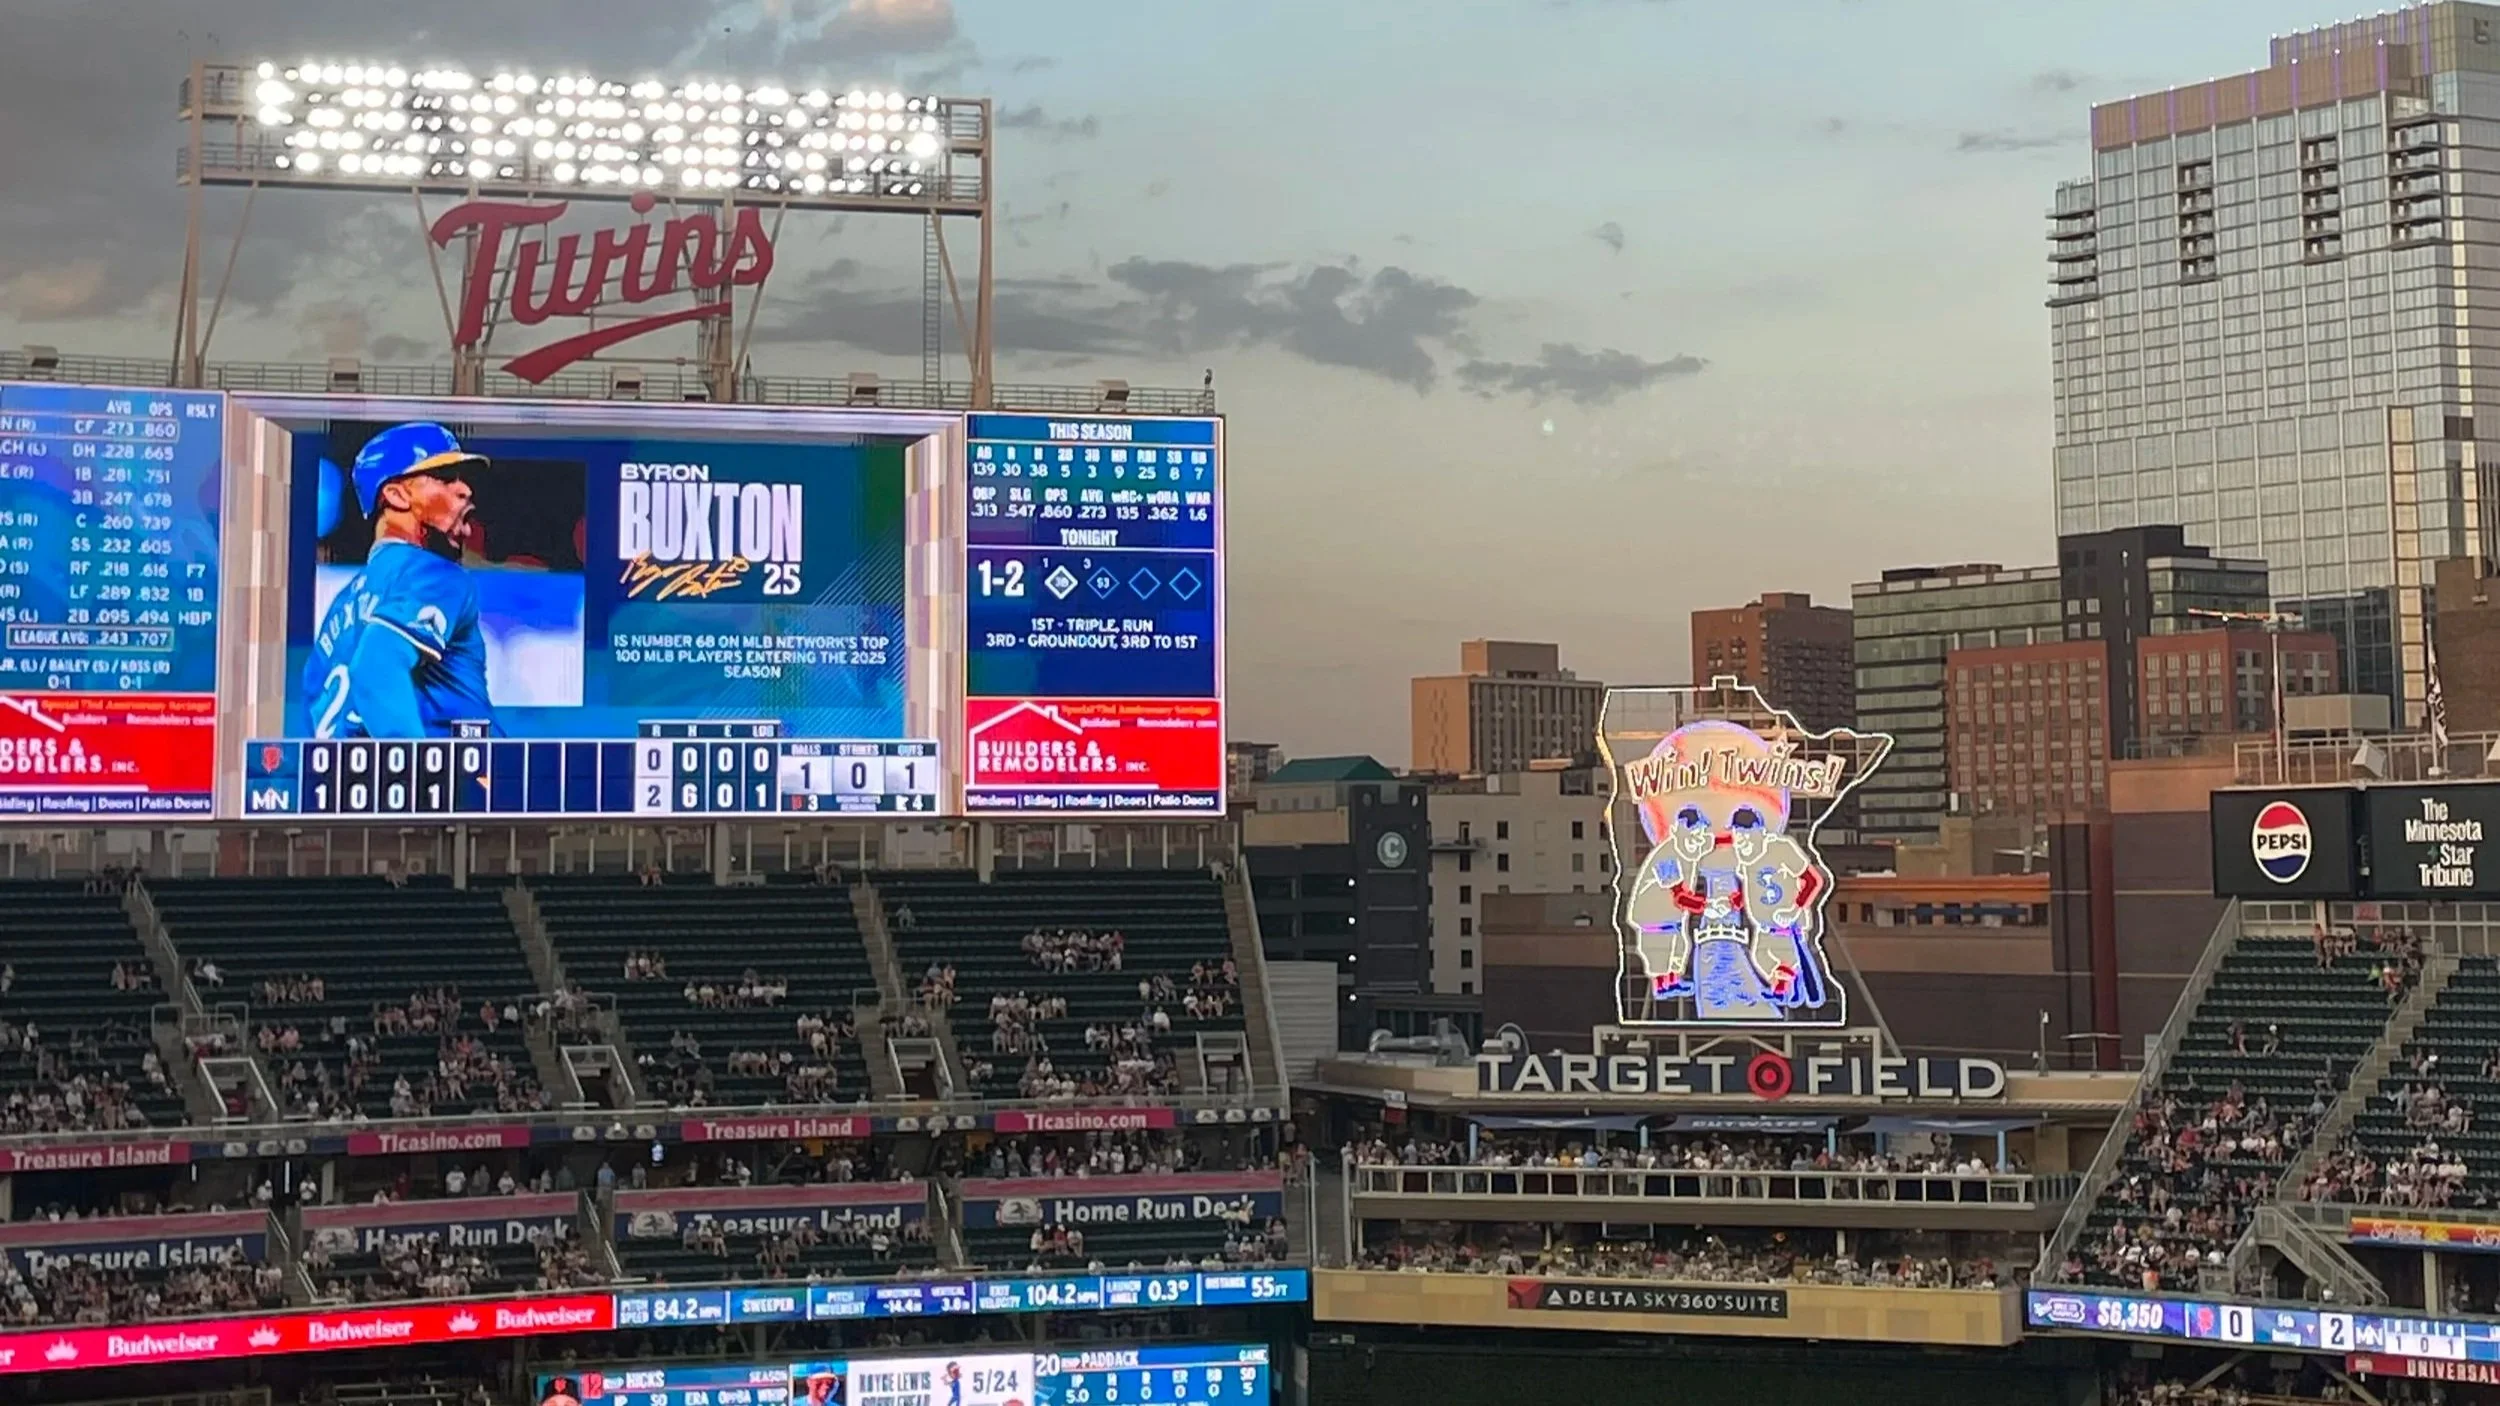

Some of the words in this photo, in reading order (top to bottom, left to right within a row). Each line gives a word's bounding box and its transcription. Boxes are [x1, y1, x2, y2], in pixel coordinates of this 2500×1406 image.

[430, 190, 773, 346] Twins
[106, 400, 131, 415] AVG
[149, 402, 173, 417] OPS
[186, 403, 216, 418] RSLT
[74, 420, 95, 434] CF
[102, 421, 134, 436] .273
[141, 423, 176, 437] .860
[1049, 423, 1078, 440] THIS
[1081, 424, 1132, 441] SEASON
[72, 443, 96, 458] DH
[102, 445, 135, 459] .228
[141, 447, 174, 461] .665
[75, 467, 92, 481] 1B
[102, 468, 131, 482] .281
[620, 463, 709, 481] BYRON
[973, 463, 995, 476] 139
[1002, 464, 1021, 477] 30
[1029, 464, 1048, 477] 38
[1138, 467, 1156, 479] 25
[71, 491, 93, 505] 3B
[100, 492, 133, 506] .247
[76, 514, 87, 527] C
[99, 516, 133, 530] .260
[619, 482, 802, 562] BUXTON
[971, 505, 998, 517] .313
[1005, 505, 1036, 518] .547
[1078, 506, 1107, 519] .273
[1148, 507, 1178, 520] .362
[71, 538, 91, 551] SS
[99, 539, 131, 553] .232
[138, 540, 172, 554] .605
[1060, 528, 1119, 546] TONIGHT
[70, 562, 91, 575] RF
[99, 563, 130, 577] .218
[139, 564, 168, 578] .616
[186, 565, 206, 579] F7
[763, 563, 801, 595] 25
[977, 559, 1025, 597] 1-2
[70, 584, 89, 599] LF
[96, 585, 131, 600] .289
[136, 586, 170, 601] .832
[187, 588, 204, 602] 1B
[68, 608, 90, 623] 2B
[96, 609, 130, 624] .095
[135, 610, 170, 624] .494
[178, 611, 212, 626] HBP
[1031, 618, 1054, 631] 1ST
[1067, 619, 1120, 633] TRIPLE,
[1123, 619, 1153, 632] RUN
[14, 630, 59, 645] LEAGUE
[96, 631, 128, 646] .243
[136, 633, 168, 646] .707
[614, 634, 629, 648] IS
[631, 634, 692, 648] NUMBER
[695, 635, 716, 648] 68
[718, 636, 740, 648] ON
[743, 636, 774, 649] MLB
[776, 636, 858, 650] NETWORK'S
[860, 637, 889, 650] TOP
[986, 634, 1016, 647] 3RD
[1028, 634, 1118, 650] GROUNDOUT,
[1121, 635, 1150, 648] 3RD
[1153, 635, 1171, 648] TO
[1175, 636, 1198, 649] 1ST
[615, 650, 641, 663] 100
[644, 650, 674, 663] MLB
[678, 650, 742, 664] PLAYERS
[746, 651, 816, 664] ENTERING
[819, 651, 847, 664] THE
[850, 652, 887, 664] 2025
[724, 666, 782, 679] SEASON
[461, 726, 482, 738] 5TH
[313, 747, 329, 773] 0
[351, 747, 367, 773] 0
[389, 747, 405, 773] 0
[426, 747, 443, 773] 0
[464, 747, 480, 773] 0
[647, 748, 660, 771] 0
[682, 747, 697, 772] 0
[718, 747, 733, 772] 0
[754, 747, 769, 772] 0
[978, 741, 1077, 757] BUILDERS
[852, 762, 866, 789] 0
[1629, 750, 1710, 800] Win!
[1719, 746, 1842, 793] Twins!
[252, 788, 289, 811] MN
[315, 784, 326, 810] 1
[351, 784, 367, 810] 0
[388, 783, 405, 809] 0
[428, 784, 440, 810] 1
[648, 785, 660, 808] 2
[682, 783, 697, 808] 6
[718, 783, 733, 808] 0
[2421, 798, 2448, 821] The
[2257, 834, 2307, 850] PEPSI
[2405, 819, 2483, 843] Minnesota
[2440, 844, 2474, 866] Star
[2419, 863, 2474, 887] Tribune
[1476, 1054, 1736, 1094] TARGET
[1808, 1057, 2004, 1098] FIELD
[703, 1121, 789, 1140] Treasure
[794, 1117, 853, 1138] Island
[11, 1150, 104, 1169] Treasure
[108, 1144, 170, 1166] Island
[1055, 1201, 1128, 1222] Home
[1137, 1198, 1185, 1220] Run
[450, 1223, 498, 1247] Run
[742, 1297, 795, 1313] SWEEPER
[1027, 1283, 1077, 1306] 104.2
[1569, 1289, 1636, 1306] DELTA
[1724, 1296, 1780, 1312] SUITE
[495, 1306, 595, 1330] Budweiser
[654, 1298, 698, 1321] 84.2
[308, 1317, 413, 1344] Budweiser
[2097, 1300, 2163, 1330] $6,350
[2230, 1310, 2242, 1337] 0
[2330, 1318, 2345, 1346] 2
[2356, 1324, 2383, 1346] MN
[107, 1333, 218, 1359] Budweiser
[1036, 1354, 1060, 1376] 20
[1081, 1351, 1138, 1367] PADDACK
[1239, 1349, 1267, 1361] GAME
[2407, 1360, 2499, 1383] UNIVERSAL
[626, 1371, 664, 1388] HICKS
[898, 1372, 931, 1390] LEWIS
[973, 1369, 1018, 1394] 5/24
[758, 1389, 787, 1404] WHIP
